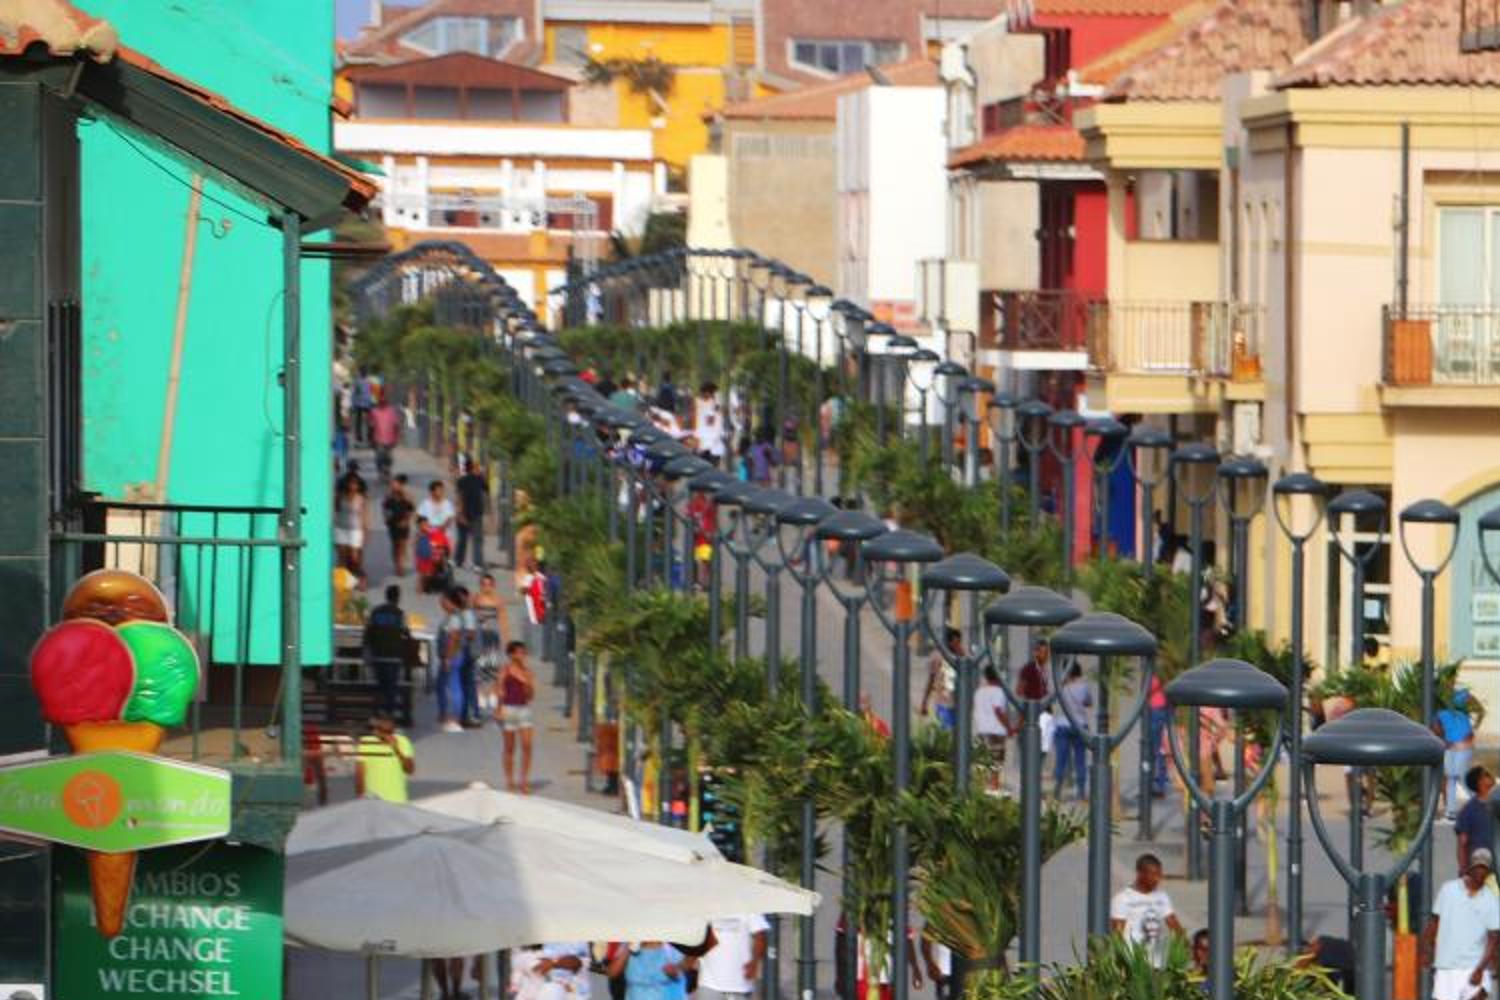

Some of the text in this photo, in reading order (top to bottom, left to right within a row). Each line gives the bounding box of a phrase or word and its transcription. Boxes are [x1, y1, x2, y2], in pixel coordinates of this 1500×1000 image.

[133, 872, 241, 897] MBIOS
[90, 903, 253, 931] CHANGE
[108, 935, 233, 963] CHANGE
[98, 968, 241, 995] WECHSEL
